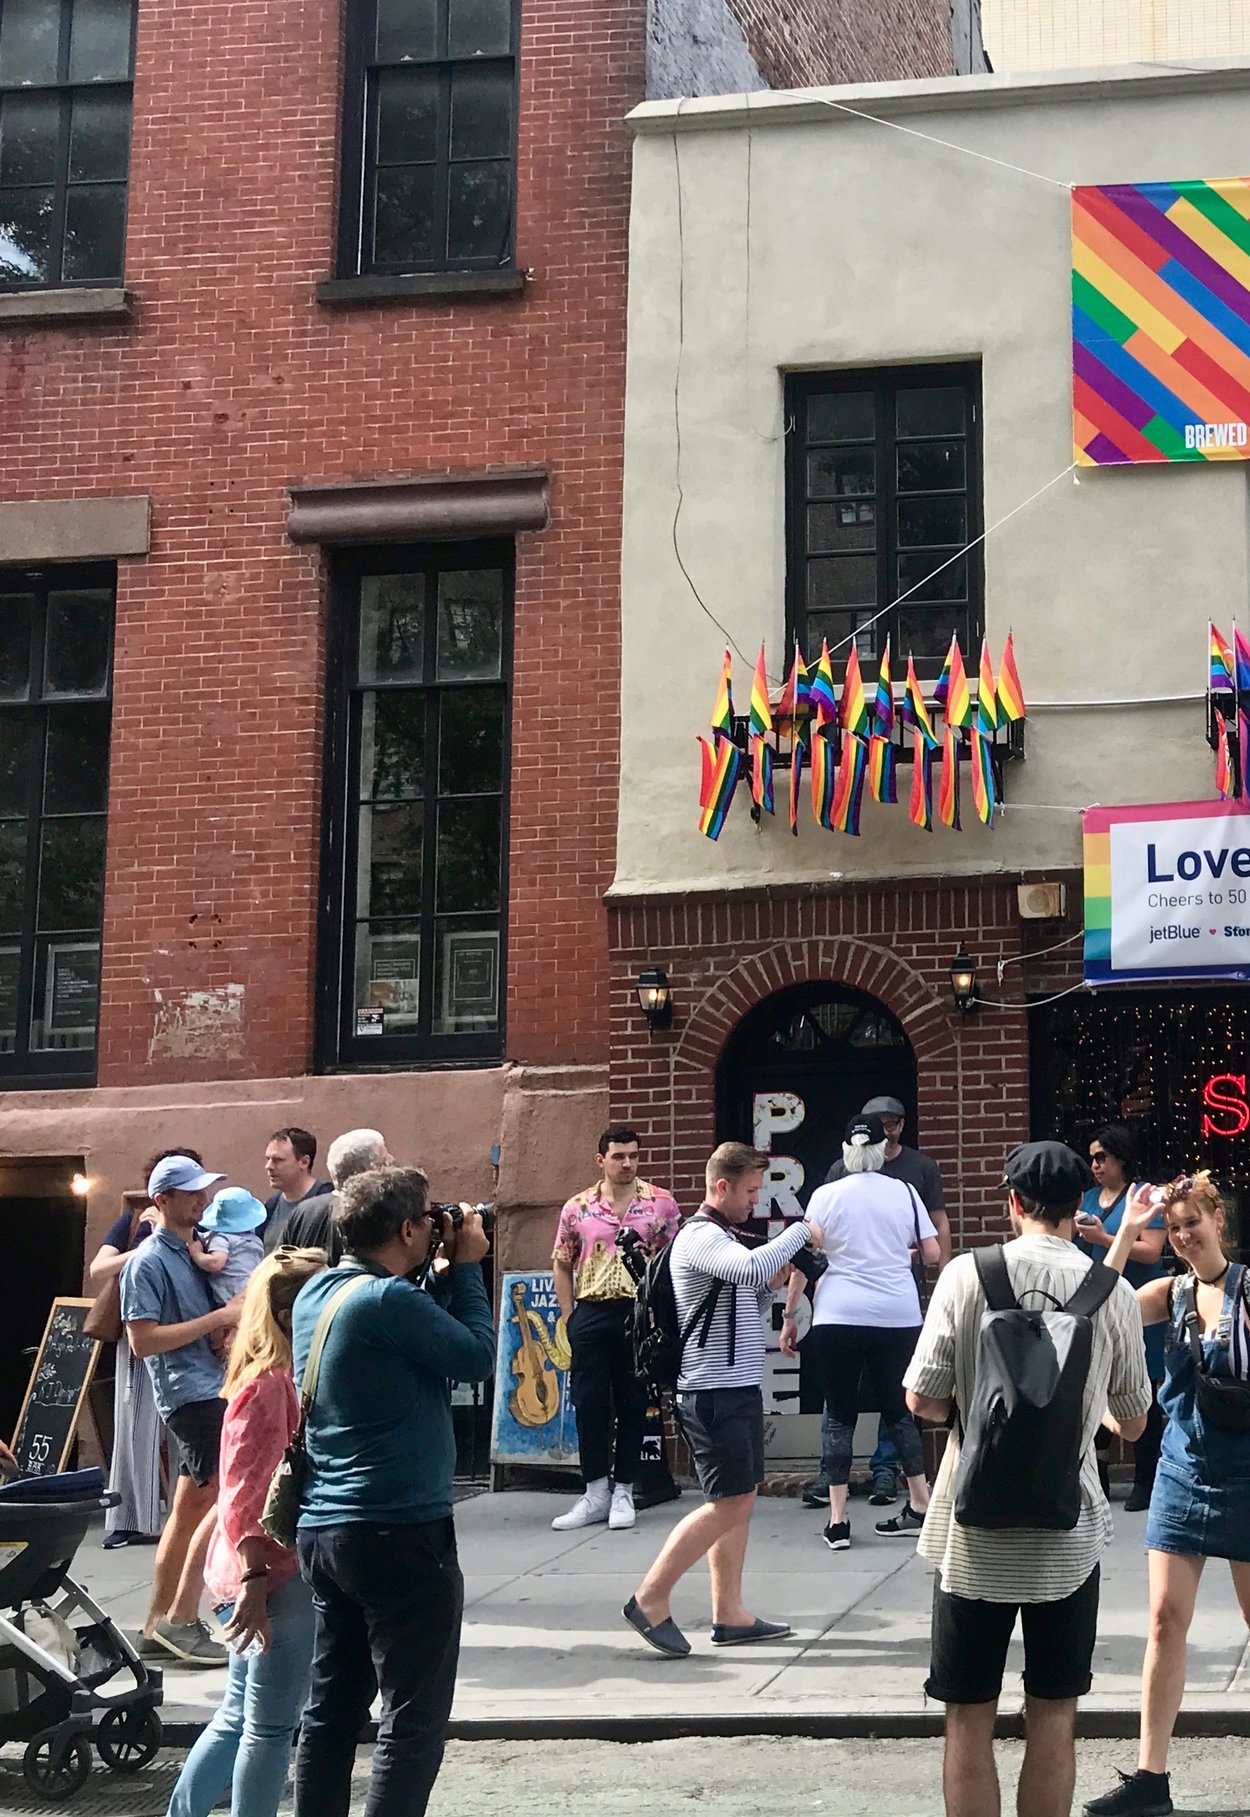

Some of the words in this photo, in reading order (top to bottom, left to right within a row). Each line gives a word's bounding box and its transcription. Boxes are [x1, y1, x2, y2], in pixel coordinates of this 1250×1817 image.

[1184, 419, 1247, 449] BREWED
[1147, 892, 1204, 909] Cheers
[1208, 891, 1222, 906] to
[1228, 890, 1248, 905] 50
[1149, 925, 1201, 944] jetBlue
[752, 1091, 812, 1415] PRDE
[531, 1278, 557, 1292] LIV
[547, 1312, 556, 1326] &
[28, 1434, 53, 1462] 55
